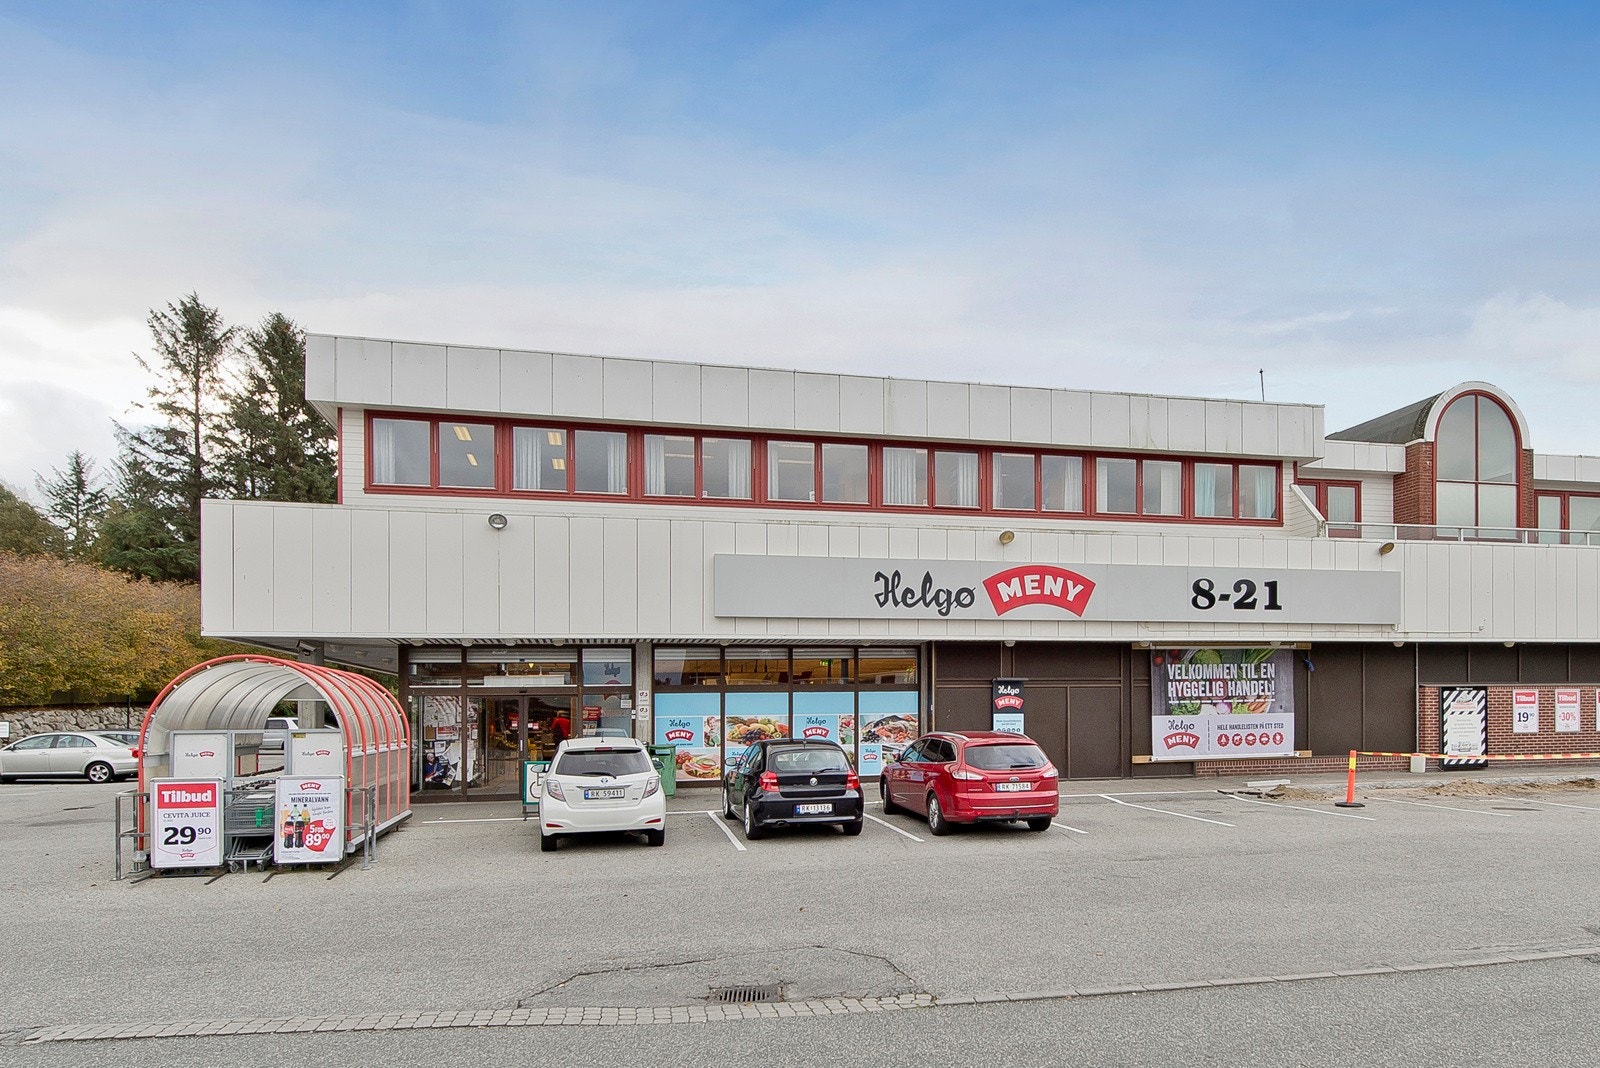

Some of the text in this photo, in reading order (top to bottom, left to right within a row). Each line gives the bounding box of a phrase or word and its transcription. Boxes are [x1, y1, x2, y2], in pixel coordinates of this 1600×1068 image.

[874, 569, 1085, 617] Helgø MENY
[1191, 577, 1283, 610] 8-21
[1167, 663, 1275, 680] VELKOMMEN TIL EN
[1168, 680, 1275, 697] HYGGELIG HANDEL!
[997, 697, 1021, 706] MENY
[1517, 712, 1529, 723] 19
[668, 731, 692, 739] MENY
[805, 728, 828, 737] MENY
[1167, 735, 1196, 746] MENY
[161, 790, 212, 803] Tilbud
[163, 826, 197, 845] 29
[305, 834, 322, 846] 89
